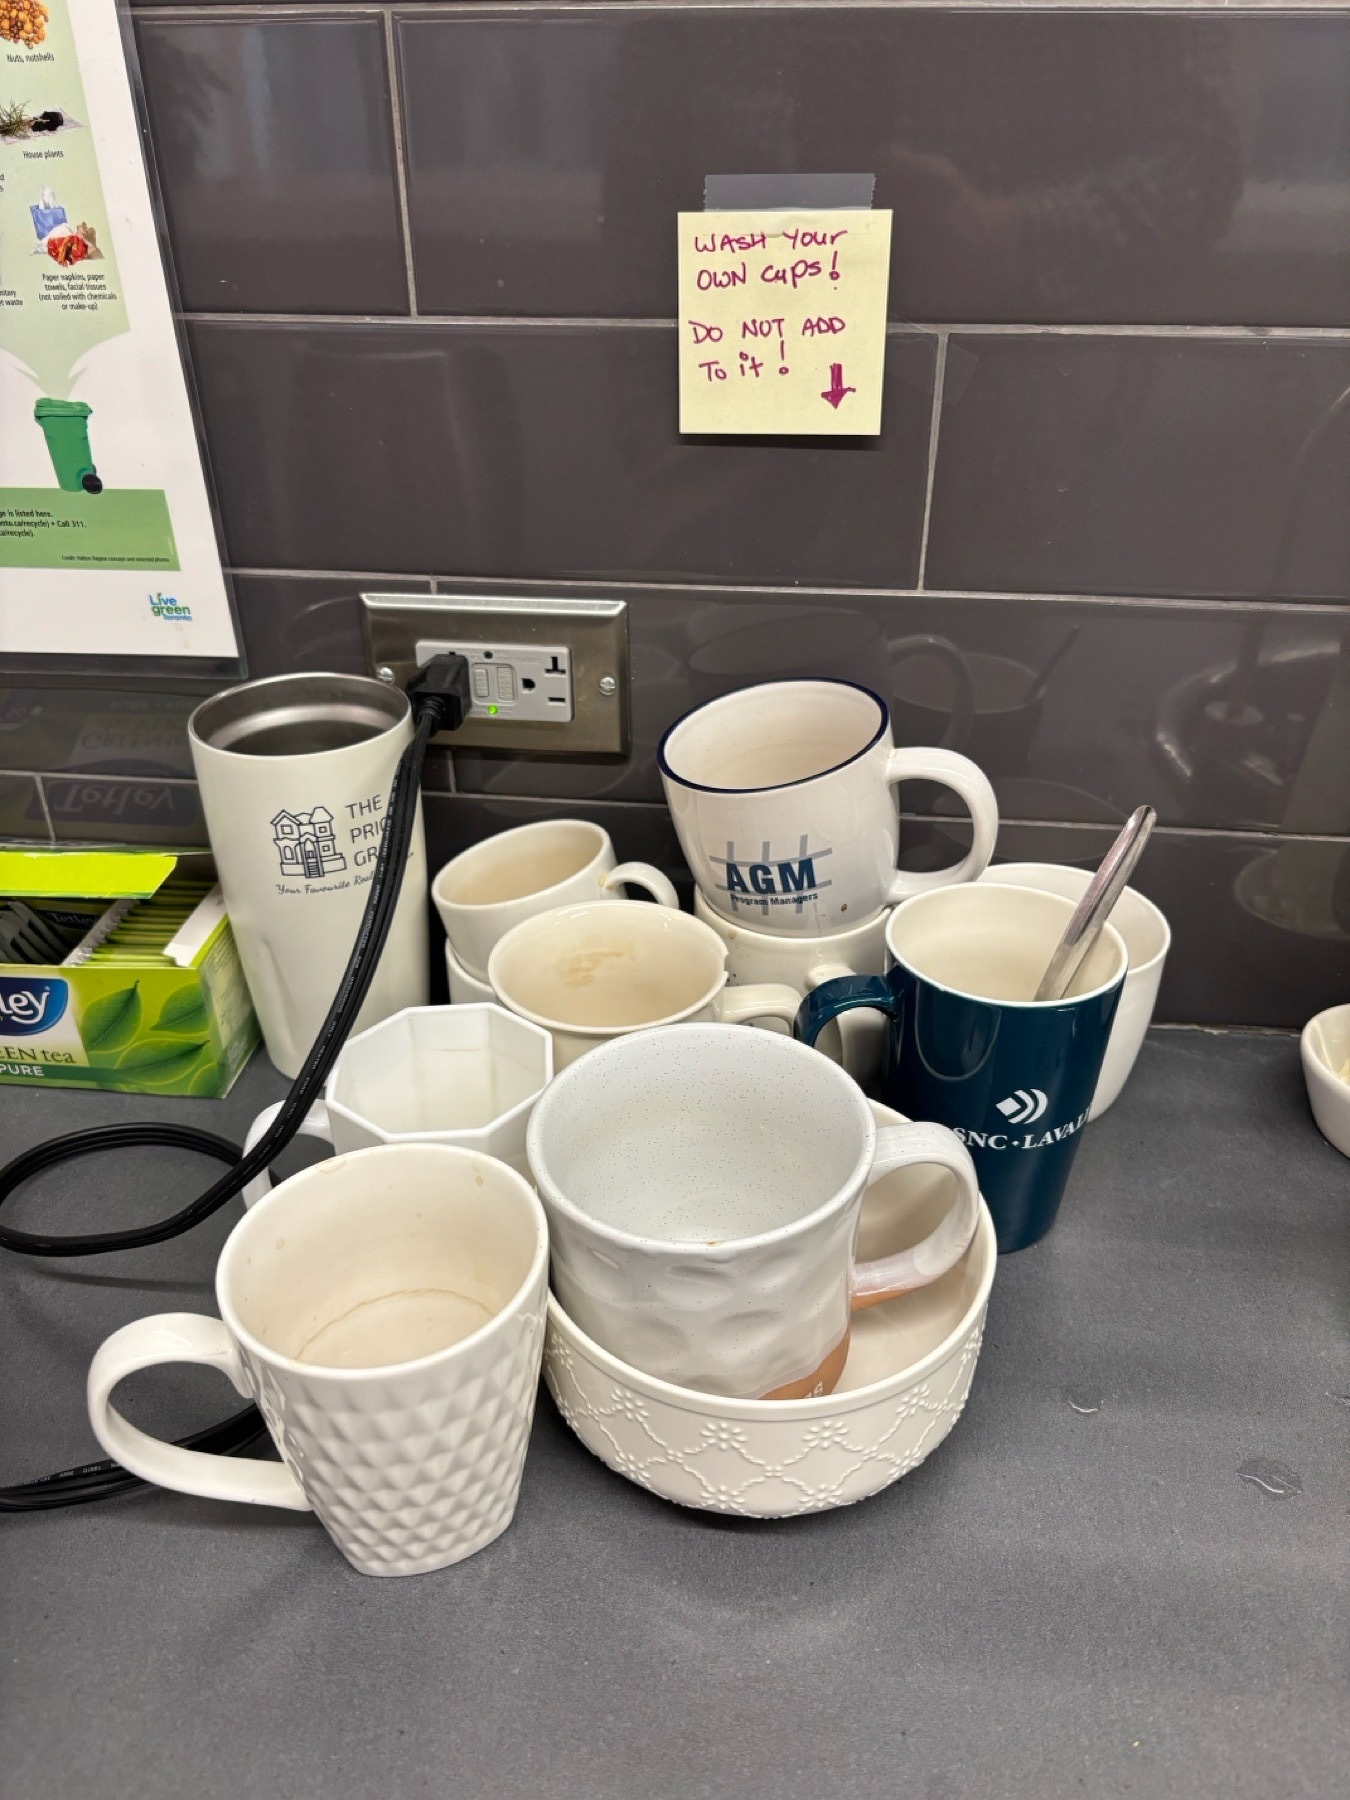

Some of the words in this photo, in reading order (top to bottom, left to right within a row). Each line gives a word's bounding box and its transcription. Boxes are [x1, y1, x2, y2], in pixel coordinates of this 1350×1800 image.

[6, 54, 24, 63] Nuts,
[25, 52, 55, 62] nutshells
[23, 150, 44, 159] House
[44, 149, 64, 160] plants
[694, 232, 767, 253] WASH
[42, 272, 59, 282] Paper
[61, 271, 86, 282] napkins,
[87, 273, 105, 282] paper
[696, 262, 747, 291] OWN
[85, 282, 107, 291] tissues
[53, 292, 70, 301] soiled
[72, 292, 86, 301] with
[87, 293, 117, 301] chemicals
[688, 320, 723, 344] DO
[741, 318, 785, 339] NOT
[801, 316, 846, 337] ADD
[8, 508, 15, 518] is
[15, 508, 35, 518] listed
[35, 508, 54, 518] here.
[57, 520, 70, 528] Call
[149, 592, 177, 606] Live
[151, 605, 191, 617] green
[345, 794, 382, 819] THE
[726, 857, 817, 894] AGM
[275, 884, 301, 895] Your
[304, 881, 350, 894] Favourite
[730, 893, 769, 906] Program
[770, 893, 818, 906] Managers
[41, 1049, 76, 1064] tea
[0, 1063, 44, 1076] PURE
